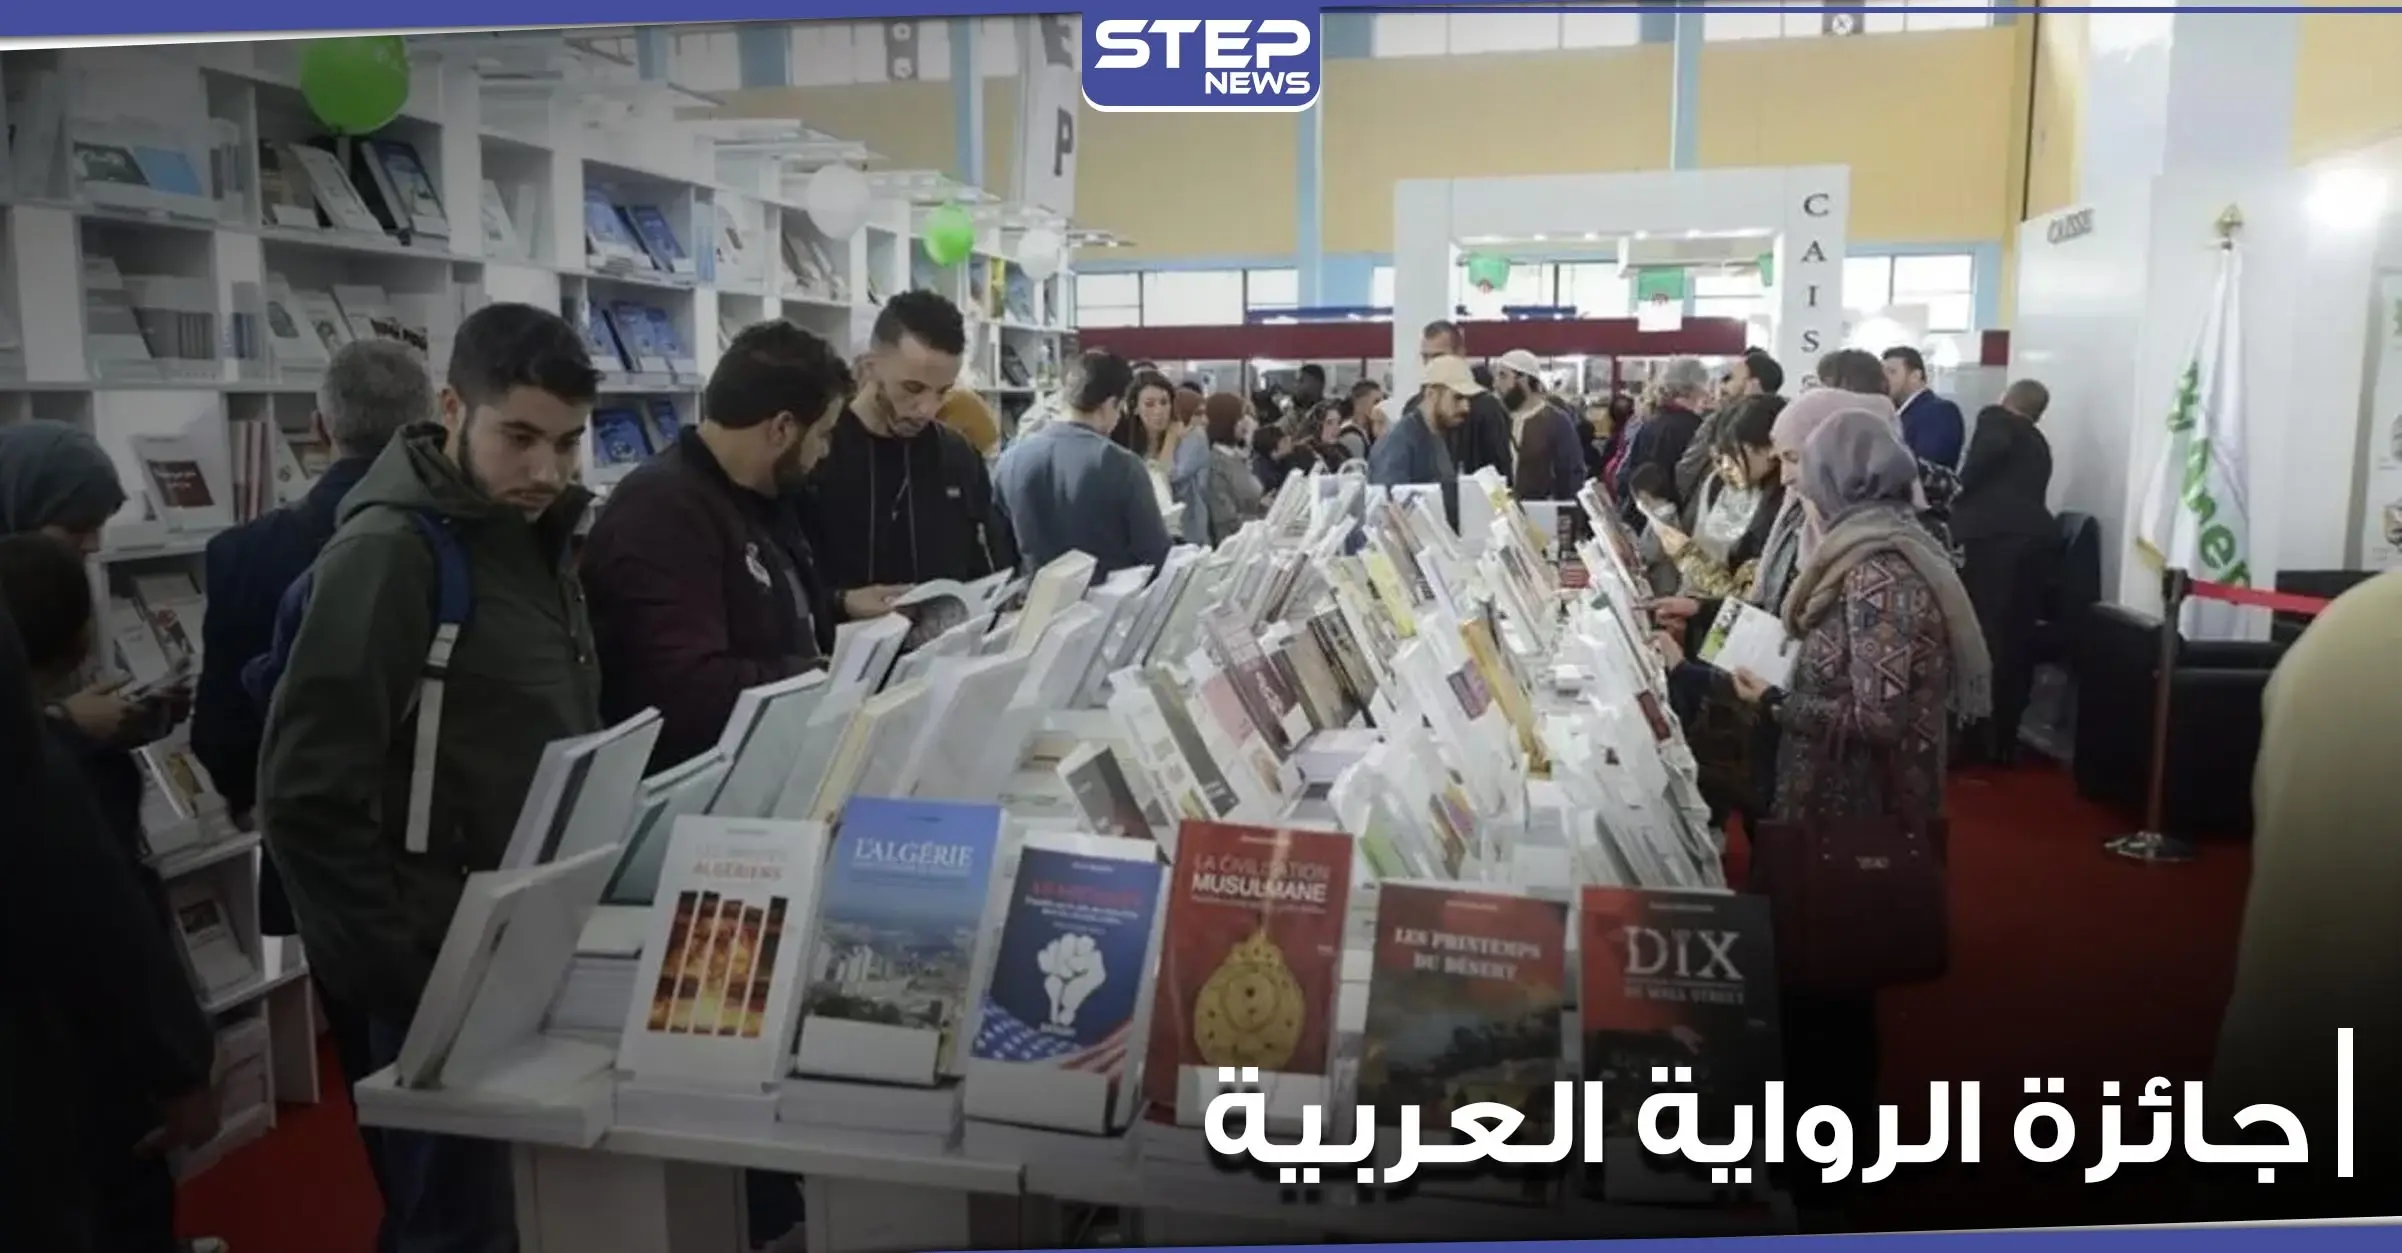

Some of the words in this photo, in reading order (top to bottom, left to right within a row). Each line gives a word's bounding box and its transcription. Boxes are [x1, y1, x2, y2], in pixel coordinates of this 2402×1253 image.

[1192, 873, 1328, 903] MUSULMANE
[1394, 926, 1429, 947] LES
[1431, 930, 1542, 961] PRINTEMPS
[1623, 925, 1745, 981] DIX
[1413, 951, 1441, 972] DU
